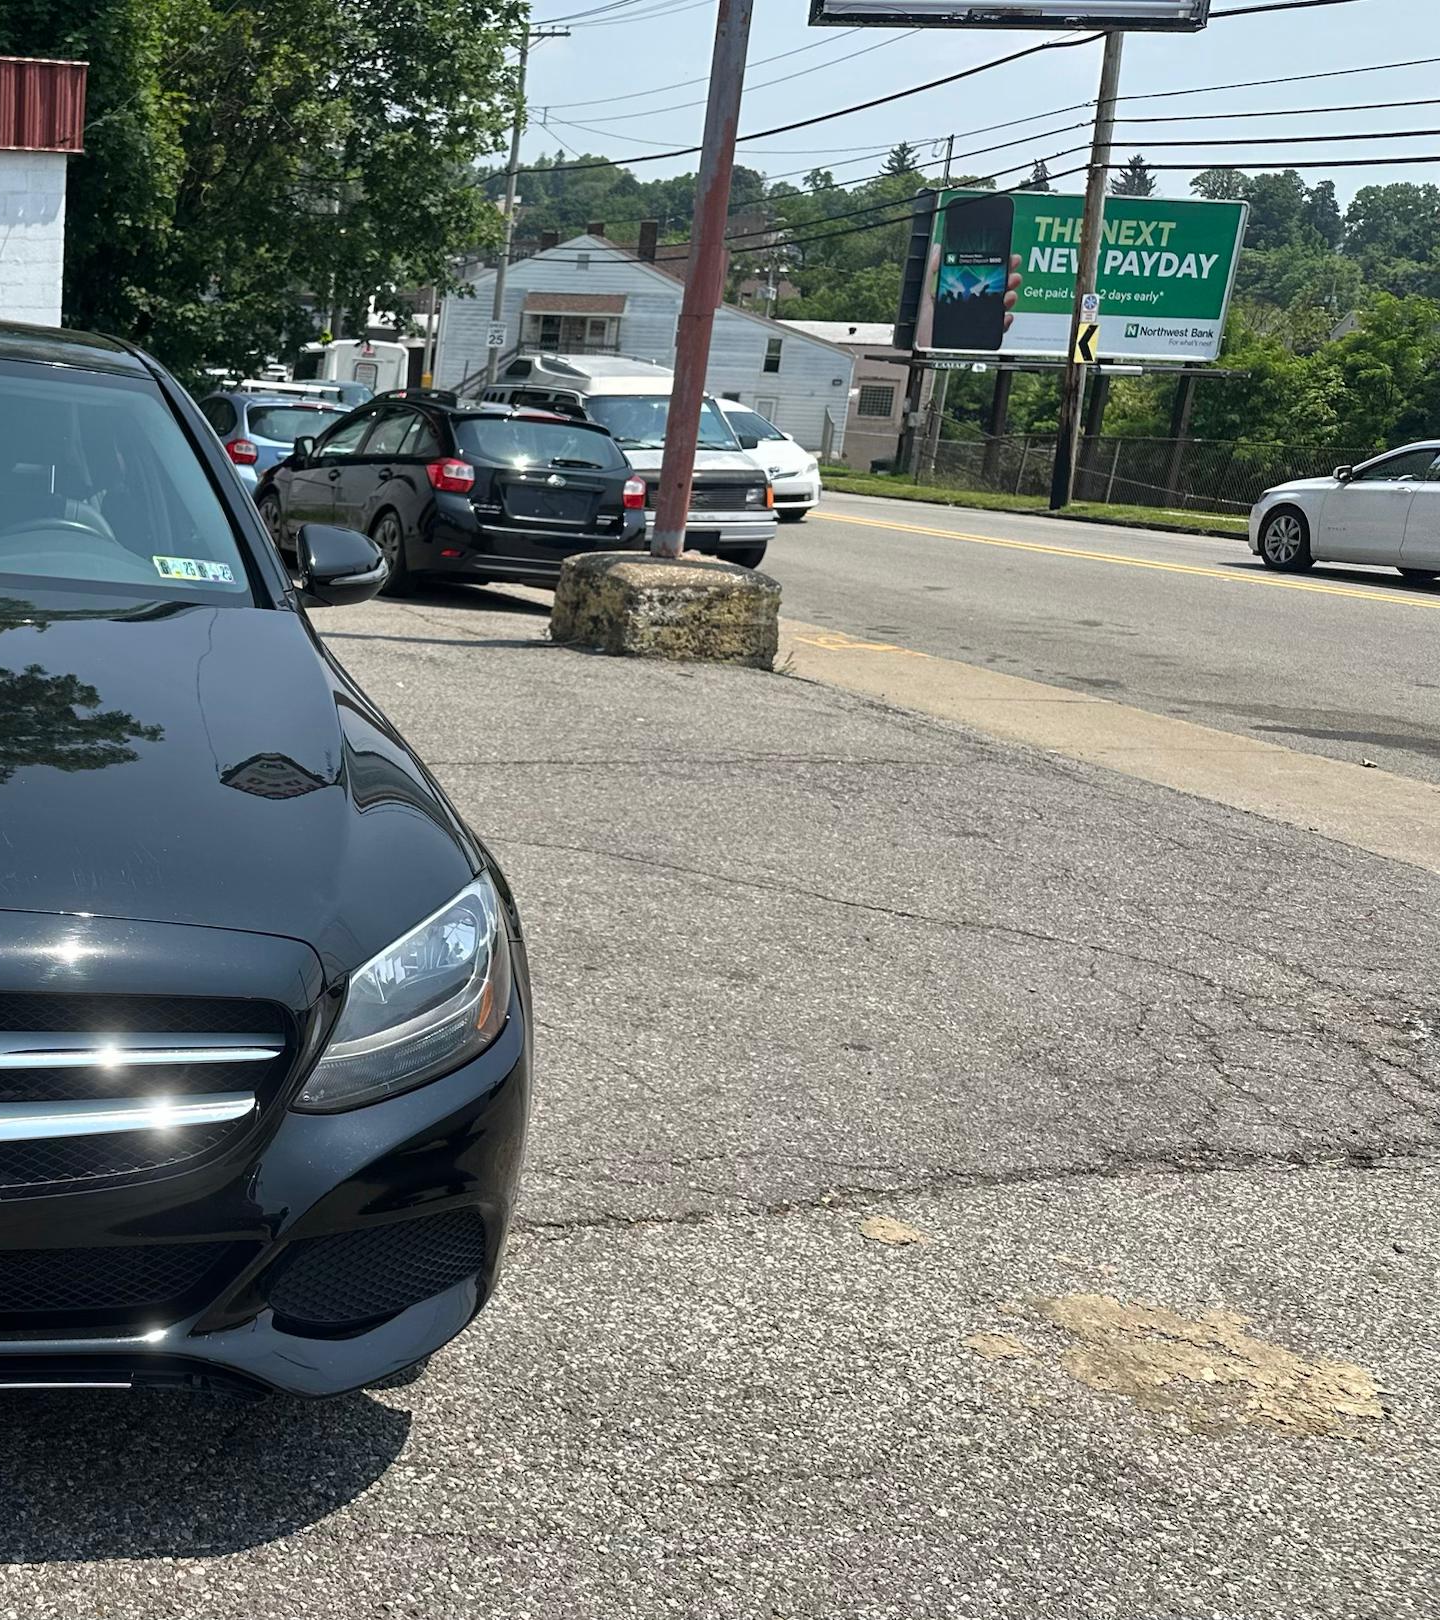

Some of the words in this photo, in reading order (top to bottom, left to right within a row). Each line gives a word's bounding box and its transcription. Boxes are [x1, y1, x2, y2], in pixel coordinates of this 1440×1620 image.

[1101, 219, 1176, 247] NEXT
[1103, 250, 1219, 279] PAYDAY
[1023, 286, 1044, 298] Get
[1045, 287, 1072, 302] paid
[1100, 289, 1107, 300] 2
[1108, 290, 1132, 304] days
[488, 334, 504, 345] 25
[1140, 326, 1188, 337] Northwest
[1191, 328, 1213, 338] Bank
